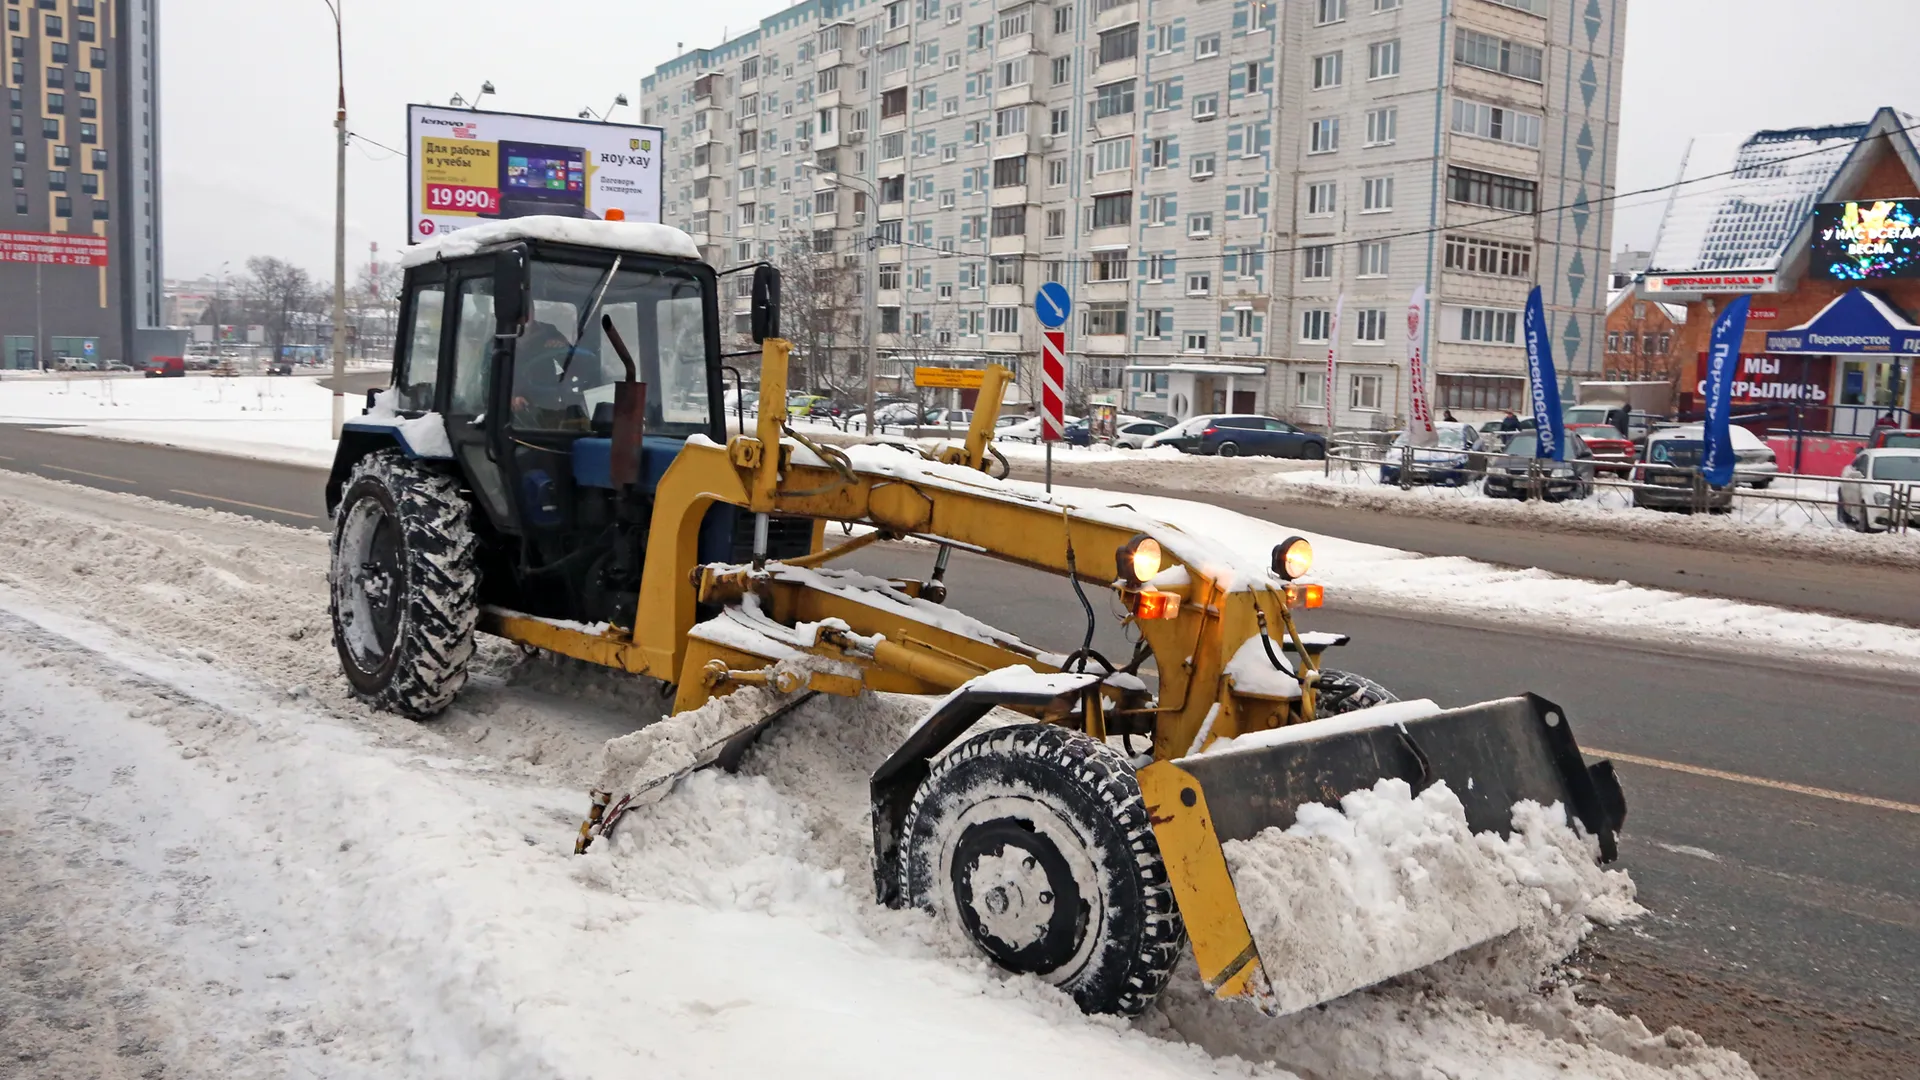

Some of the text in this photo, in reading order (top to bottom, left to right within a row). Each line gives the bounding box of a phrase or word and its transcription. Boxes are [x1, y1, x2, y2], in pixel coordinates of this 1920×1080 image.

[426, 142, 490, 157] Для работы
[436, 157, 472, 168] учебы
[431, 188, 489, 208] 19 990
[1835, 227, 1865, 240] НАС
[1848, 242, 1894, 255] ВЕСНА
[1808, 333, 1891, 347] Перекресток
[1744, 358, 1780, 375] МЫ
